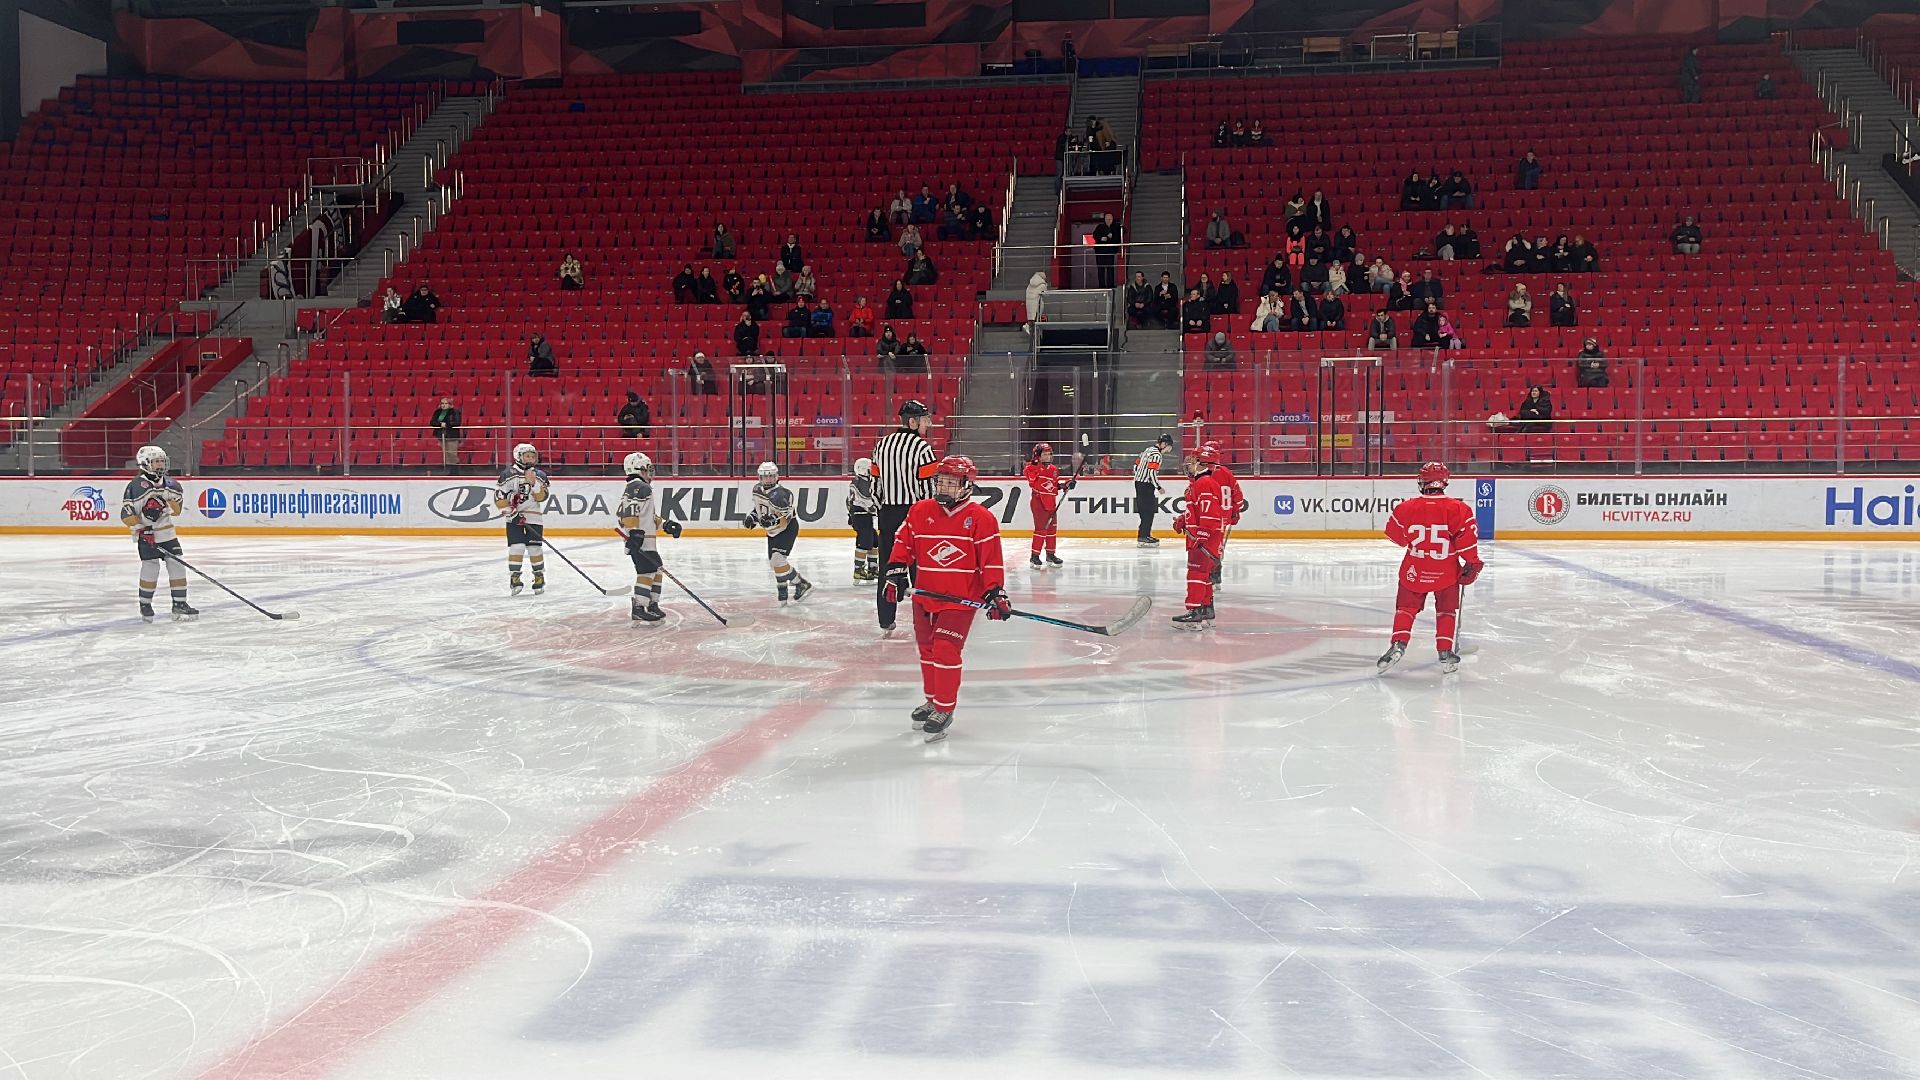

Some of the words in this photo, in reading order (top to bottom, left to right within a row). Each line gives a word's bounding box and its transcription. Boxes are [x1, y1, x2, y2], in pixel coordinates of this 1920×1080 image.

[233, 488, 401, 519] севернефтегазпром
[543, 494, 610, 515] ADA
[1576, 492, 1650, 506] БИЛЕТЫ
[1655, 488, 1728, 506] ОНЛАЙН
[61, 500, 93, 511] АВТО
[1200, 500, 1211, 513] 17
[1825, 484, 1920, 526] Hai
[69, 511, 109, 521] РАДИО
[1602, 511, 1692, 522] HCVITYAZ.RU
[1407, 524, 1450, 560] 25
[935, 627, 964, 640] BAUER
